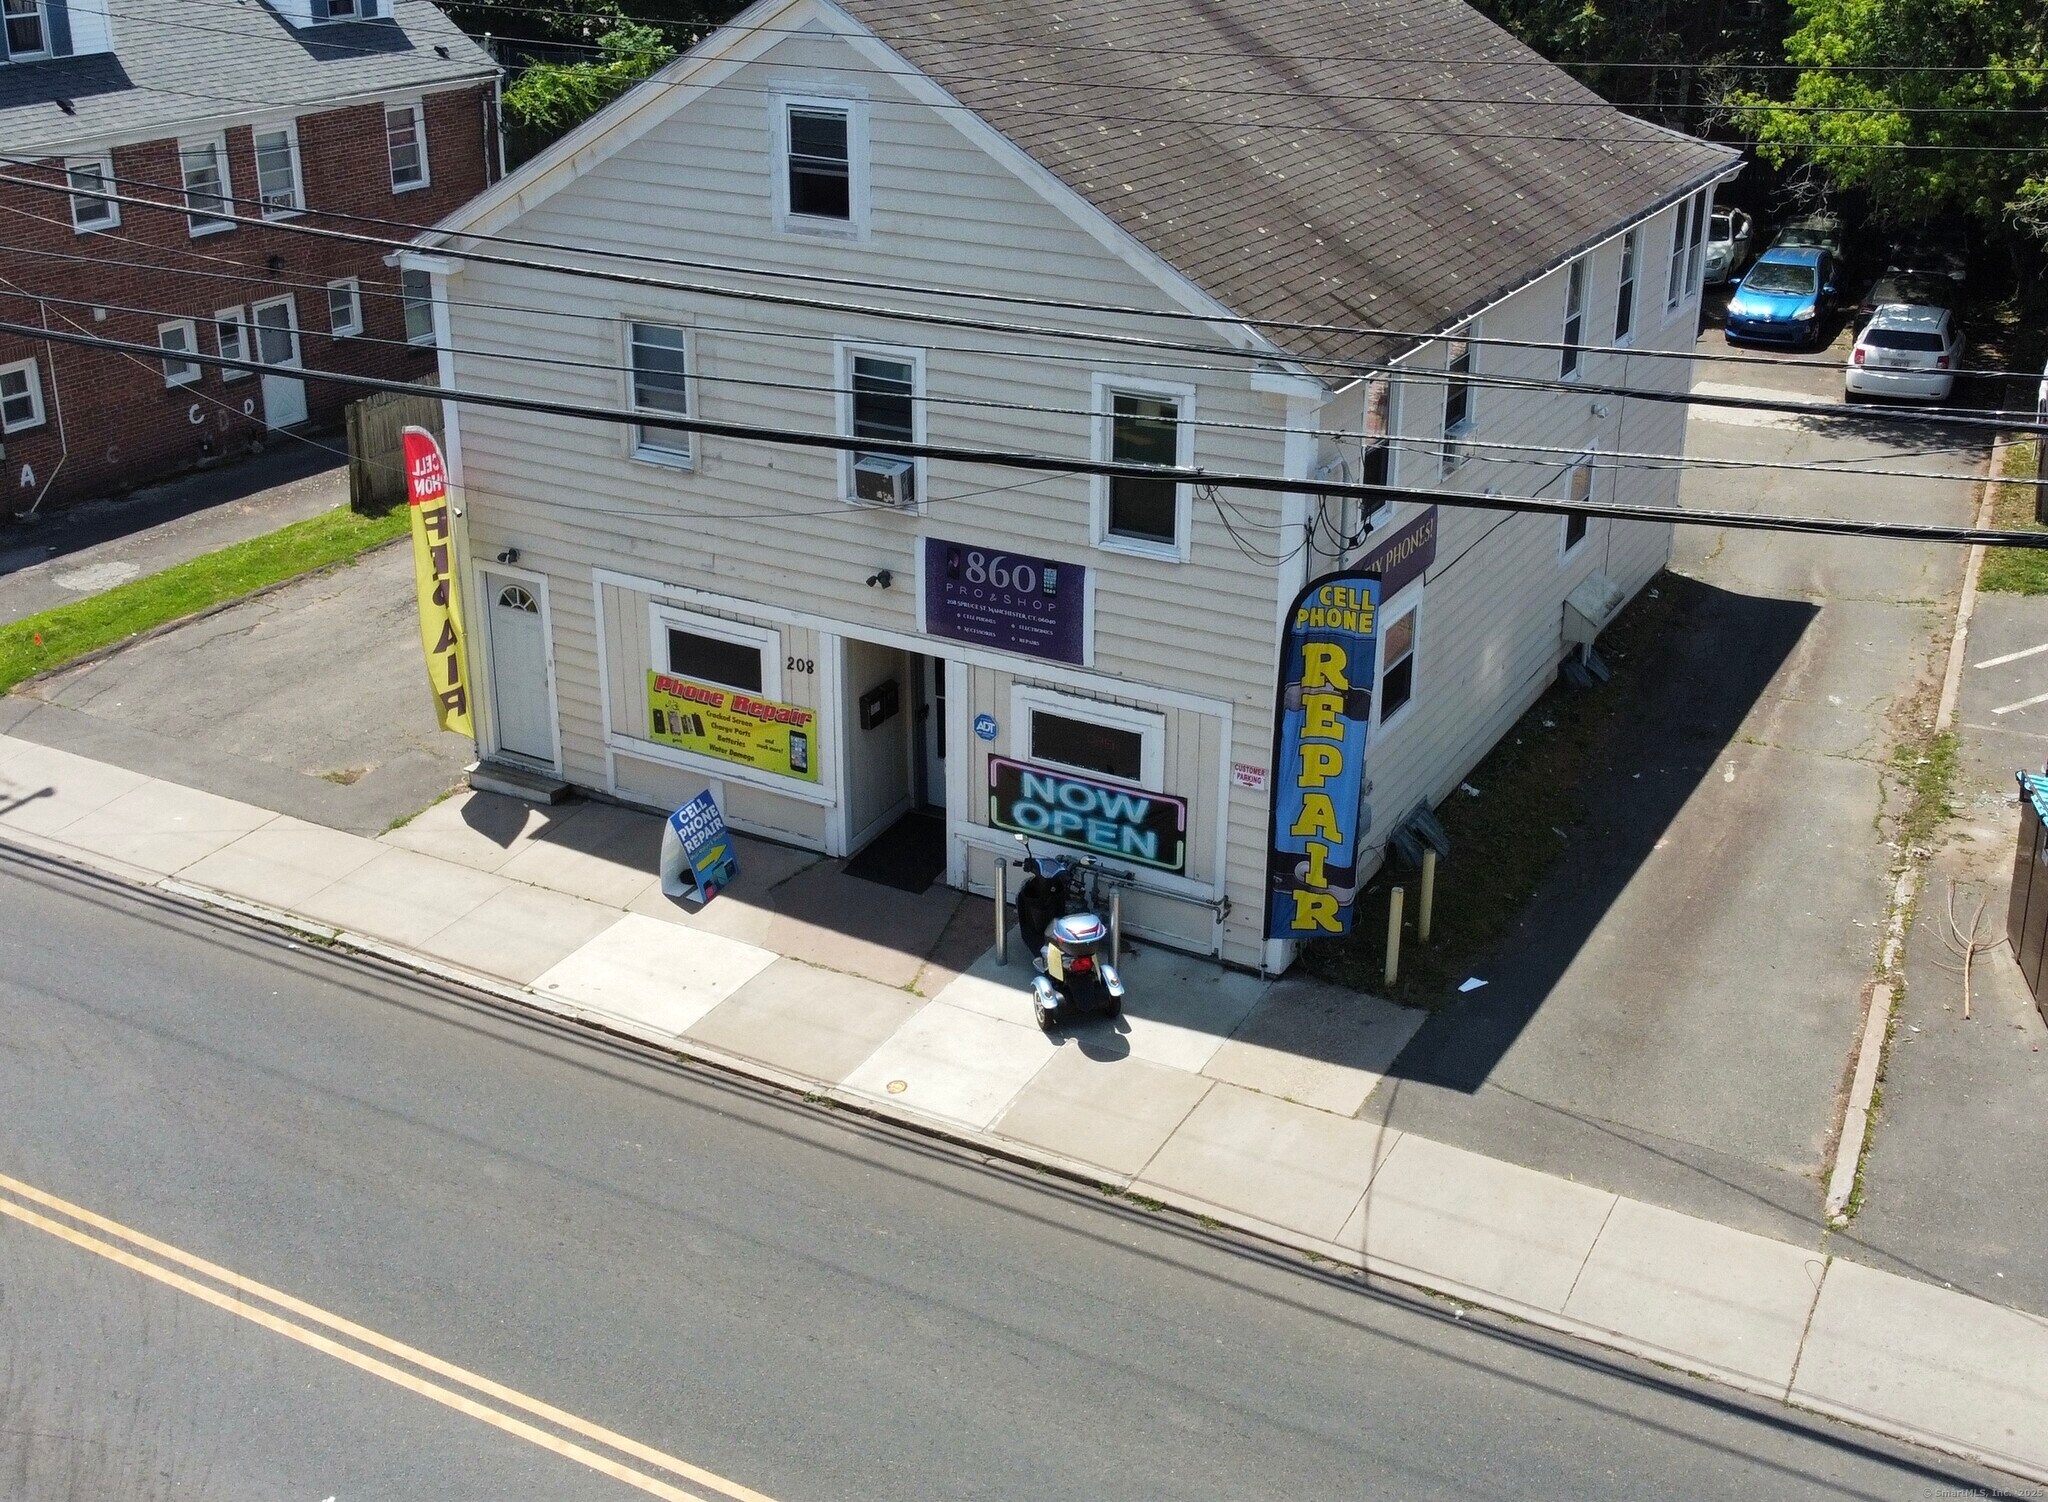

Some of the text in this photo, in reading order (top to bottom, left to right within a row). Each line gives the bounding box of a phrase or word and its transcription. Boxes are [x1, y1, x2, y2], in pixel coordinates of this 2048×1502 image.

[189, 403, 205, 424] C
[20, 464, 36, 487] A
[1386, 518, 1434, 573] PHONES!
[965, 551, 1036, 593] 860
[957, 600, 979, 610] SPRUCE
[1318, 586, 1375, 611] CELL
[1018, 624, 1053, 636] ELECTRONICS
[1296, 605, 1374, 634] PHONE
[1019, 637, 1040, 646] REPAIRS
[786, 656, 814, 674] 208
[654, 674, 812, 727] Phone Repair
[706, 710, 753, 727] Cracked Screen
[711, 722, 751, 737] Charge Ports
[976, 720, 995, 733] ADT
[709, 743, 755, 761] Water Damage
[717, 735, 746, 748] Batteries
[1234, 763, 1265, 777] CUSTOMER
[1236, 772, 1262, 785] PARKING
[1021, 771, 1150, 824] NOW
[1290, 641, 1350, 934] REPAIR
[678, 798, 708, 824] CELL
[678, 804, 719, 841] PHONE
[1012, 800, 1158, 859] OPEN
[683, 817, 724, 854] REPAIR
